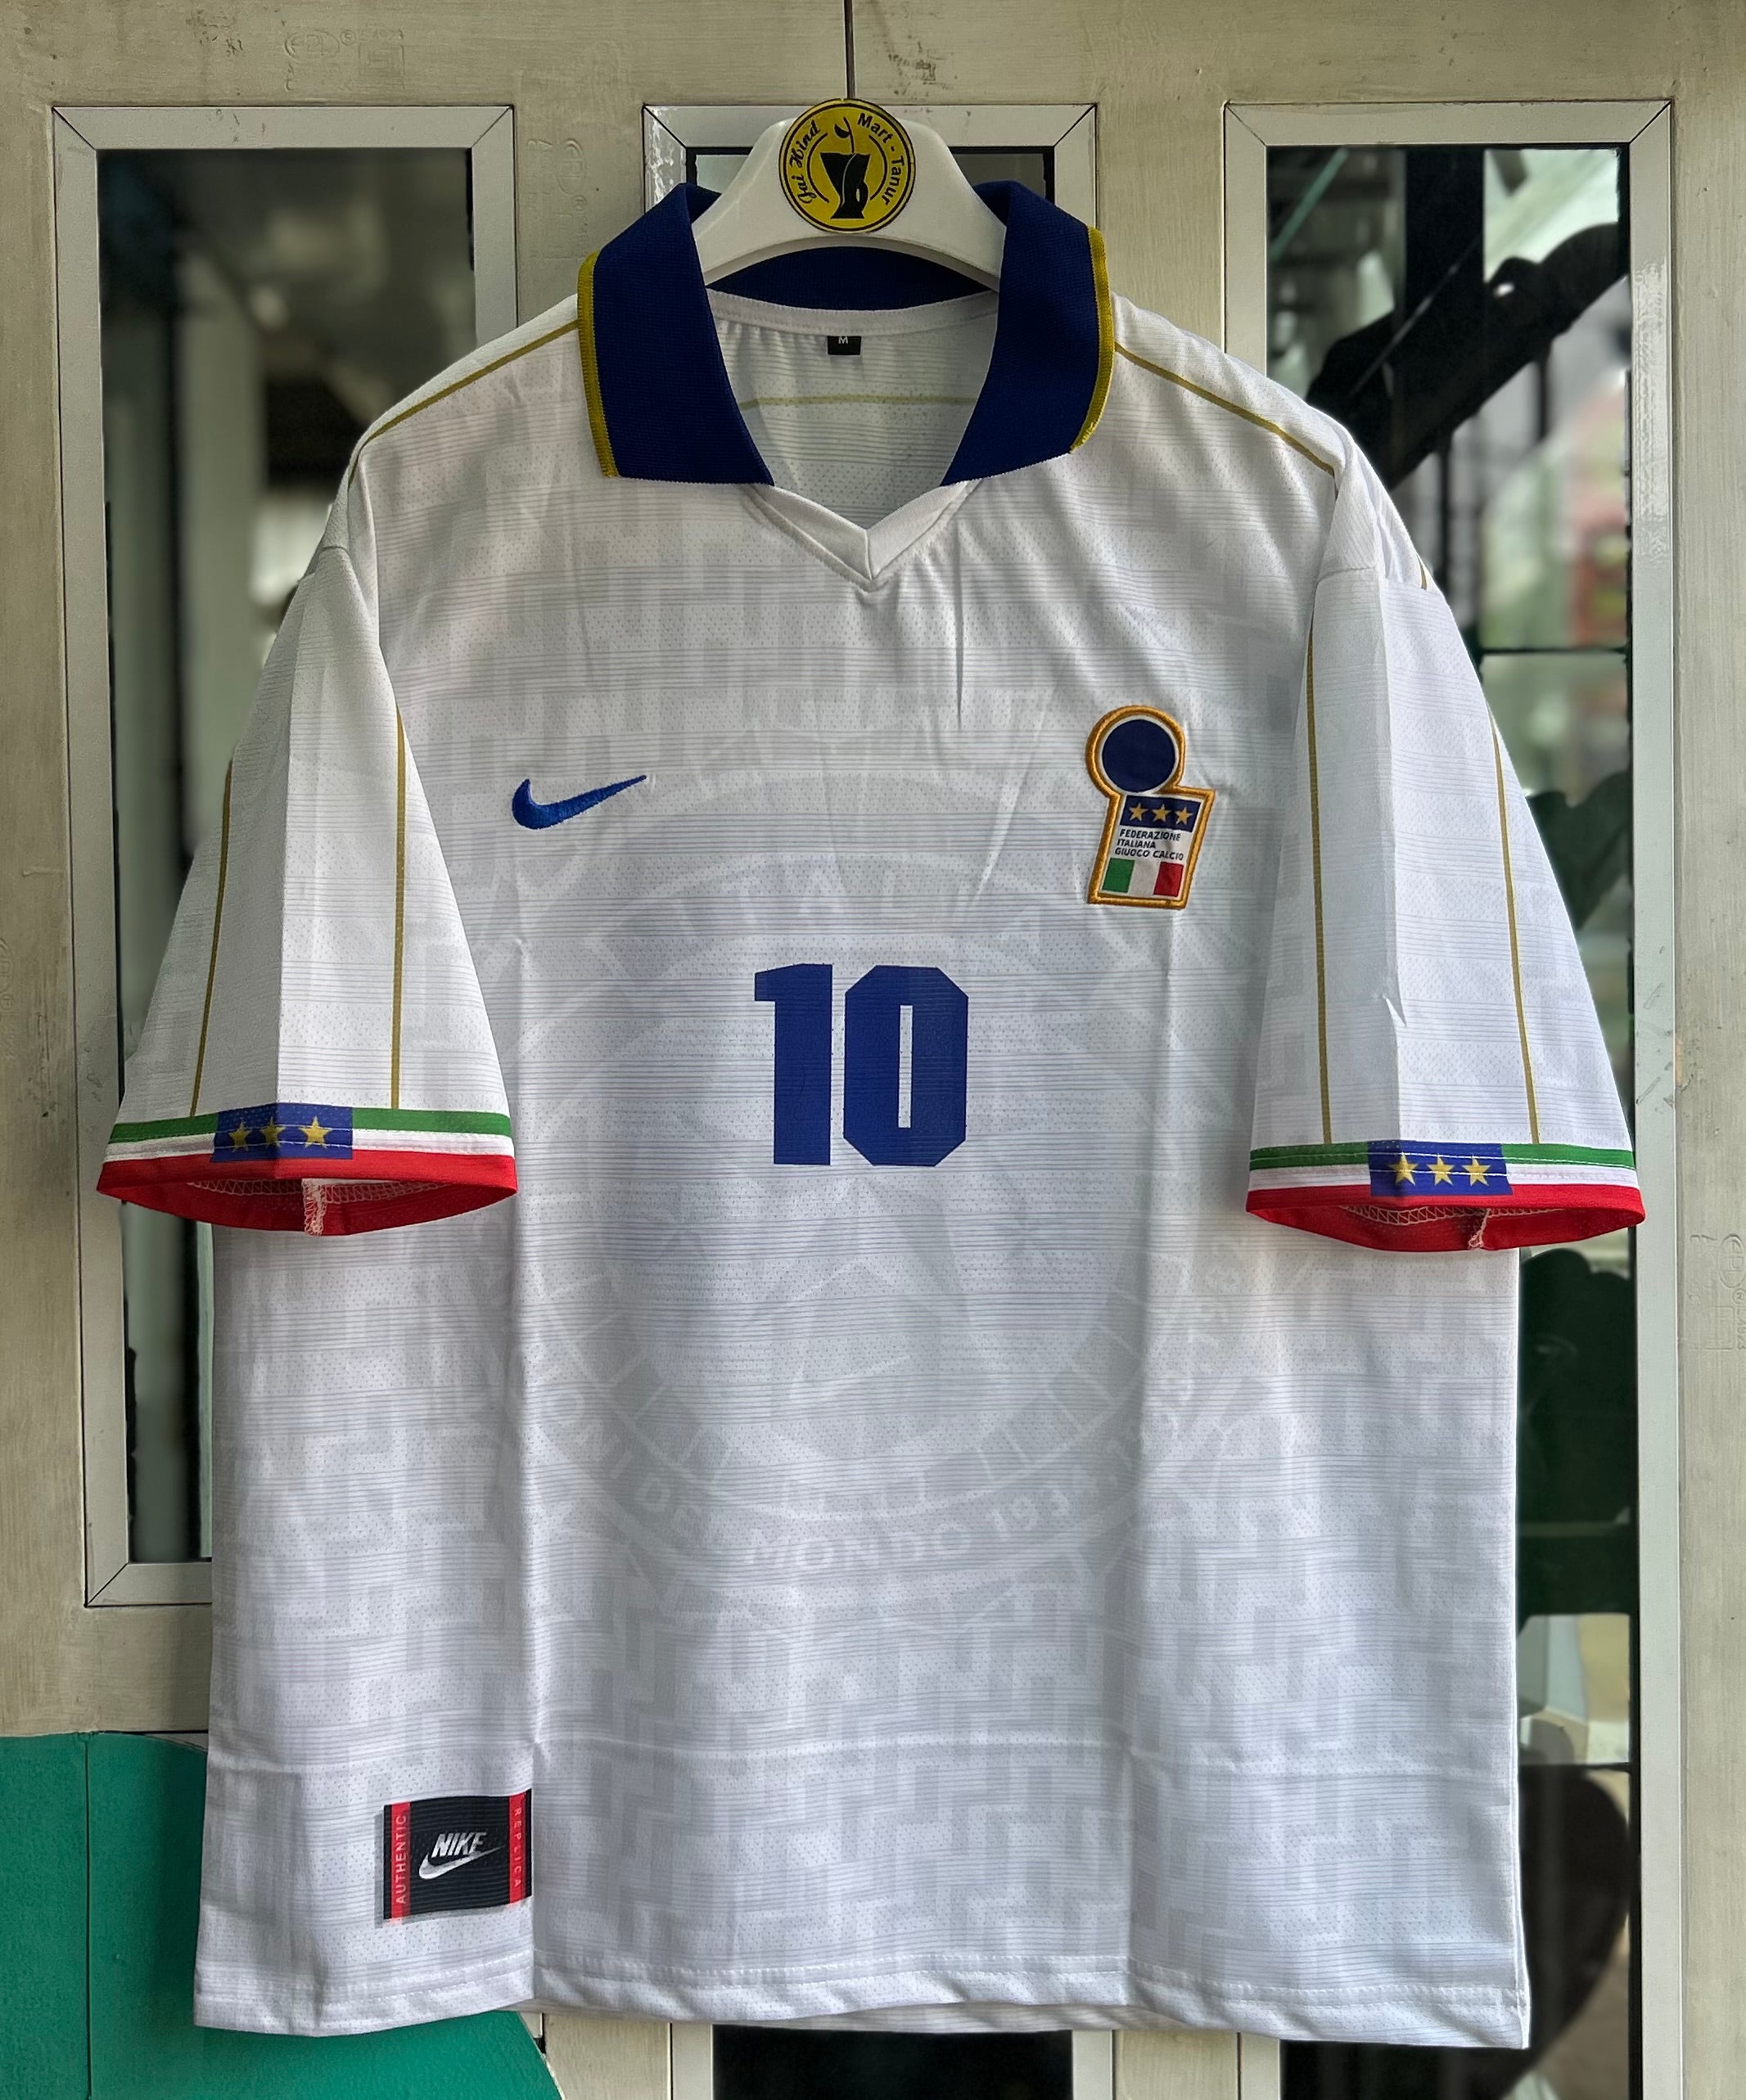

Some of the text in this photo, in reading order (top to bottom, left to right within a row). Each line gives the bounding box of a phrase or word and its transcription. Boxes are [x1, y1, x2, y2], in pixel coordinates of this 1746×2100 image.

[790, 119, 820, 168] Hind
[857, 113, 894, 143] Mart
[882, 155, 905, 205] Tanur
[838, 336, 849, 345] M
[1115, 848, 1184, 861] GIUOCO CALCIO
[1117, 838, 1156, 849] ITALIANA
[1119, 828, 1181, 841] FEDERAZIONE
[754, 963, 969, 1167] 10
[743, 1520, 971, 1574] MONDO
[395, 1814, 407, 1904] AUTHENTIC
[431, 1832, 487, 1858] NIKE
[514, 1807, 522, 1887] REPLICA
